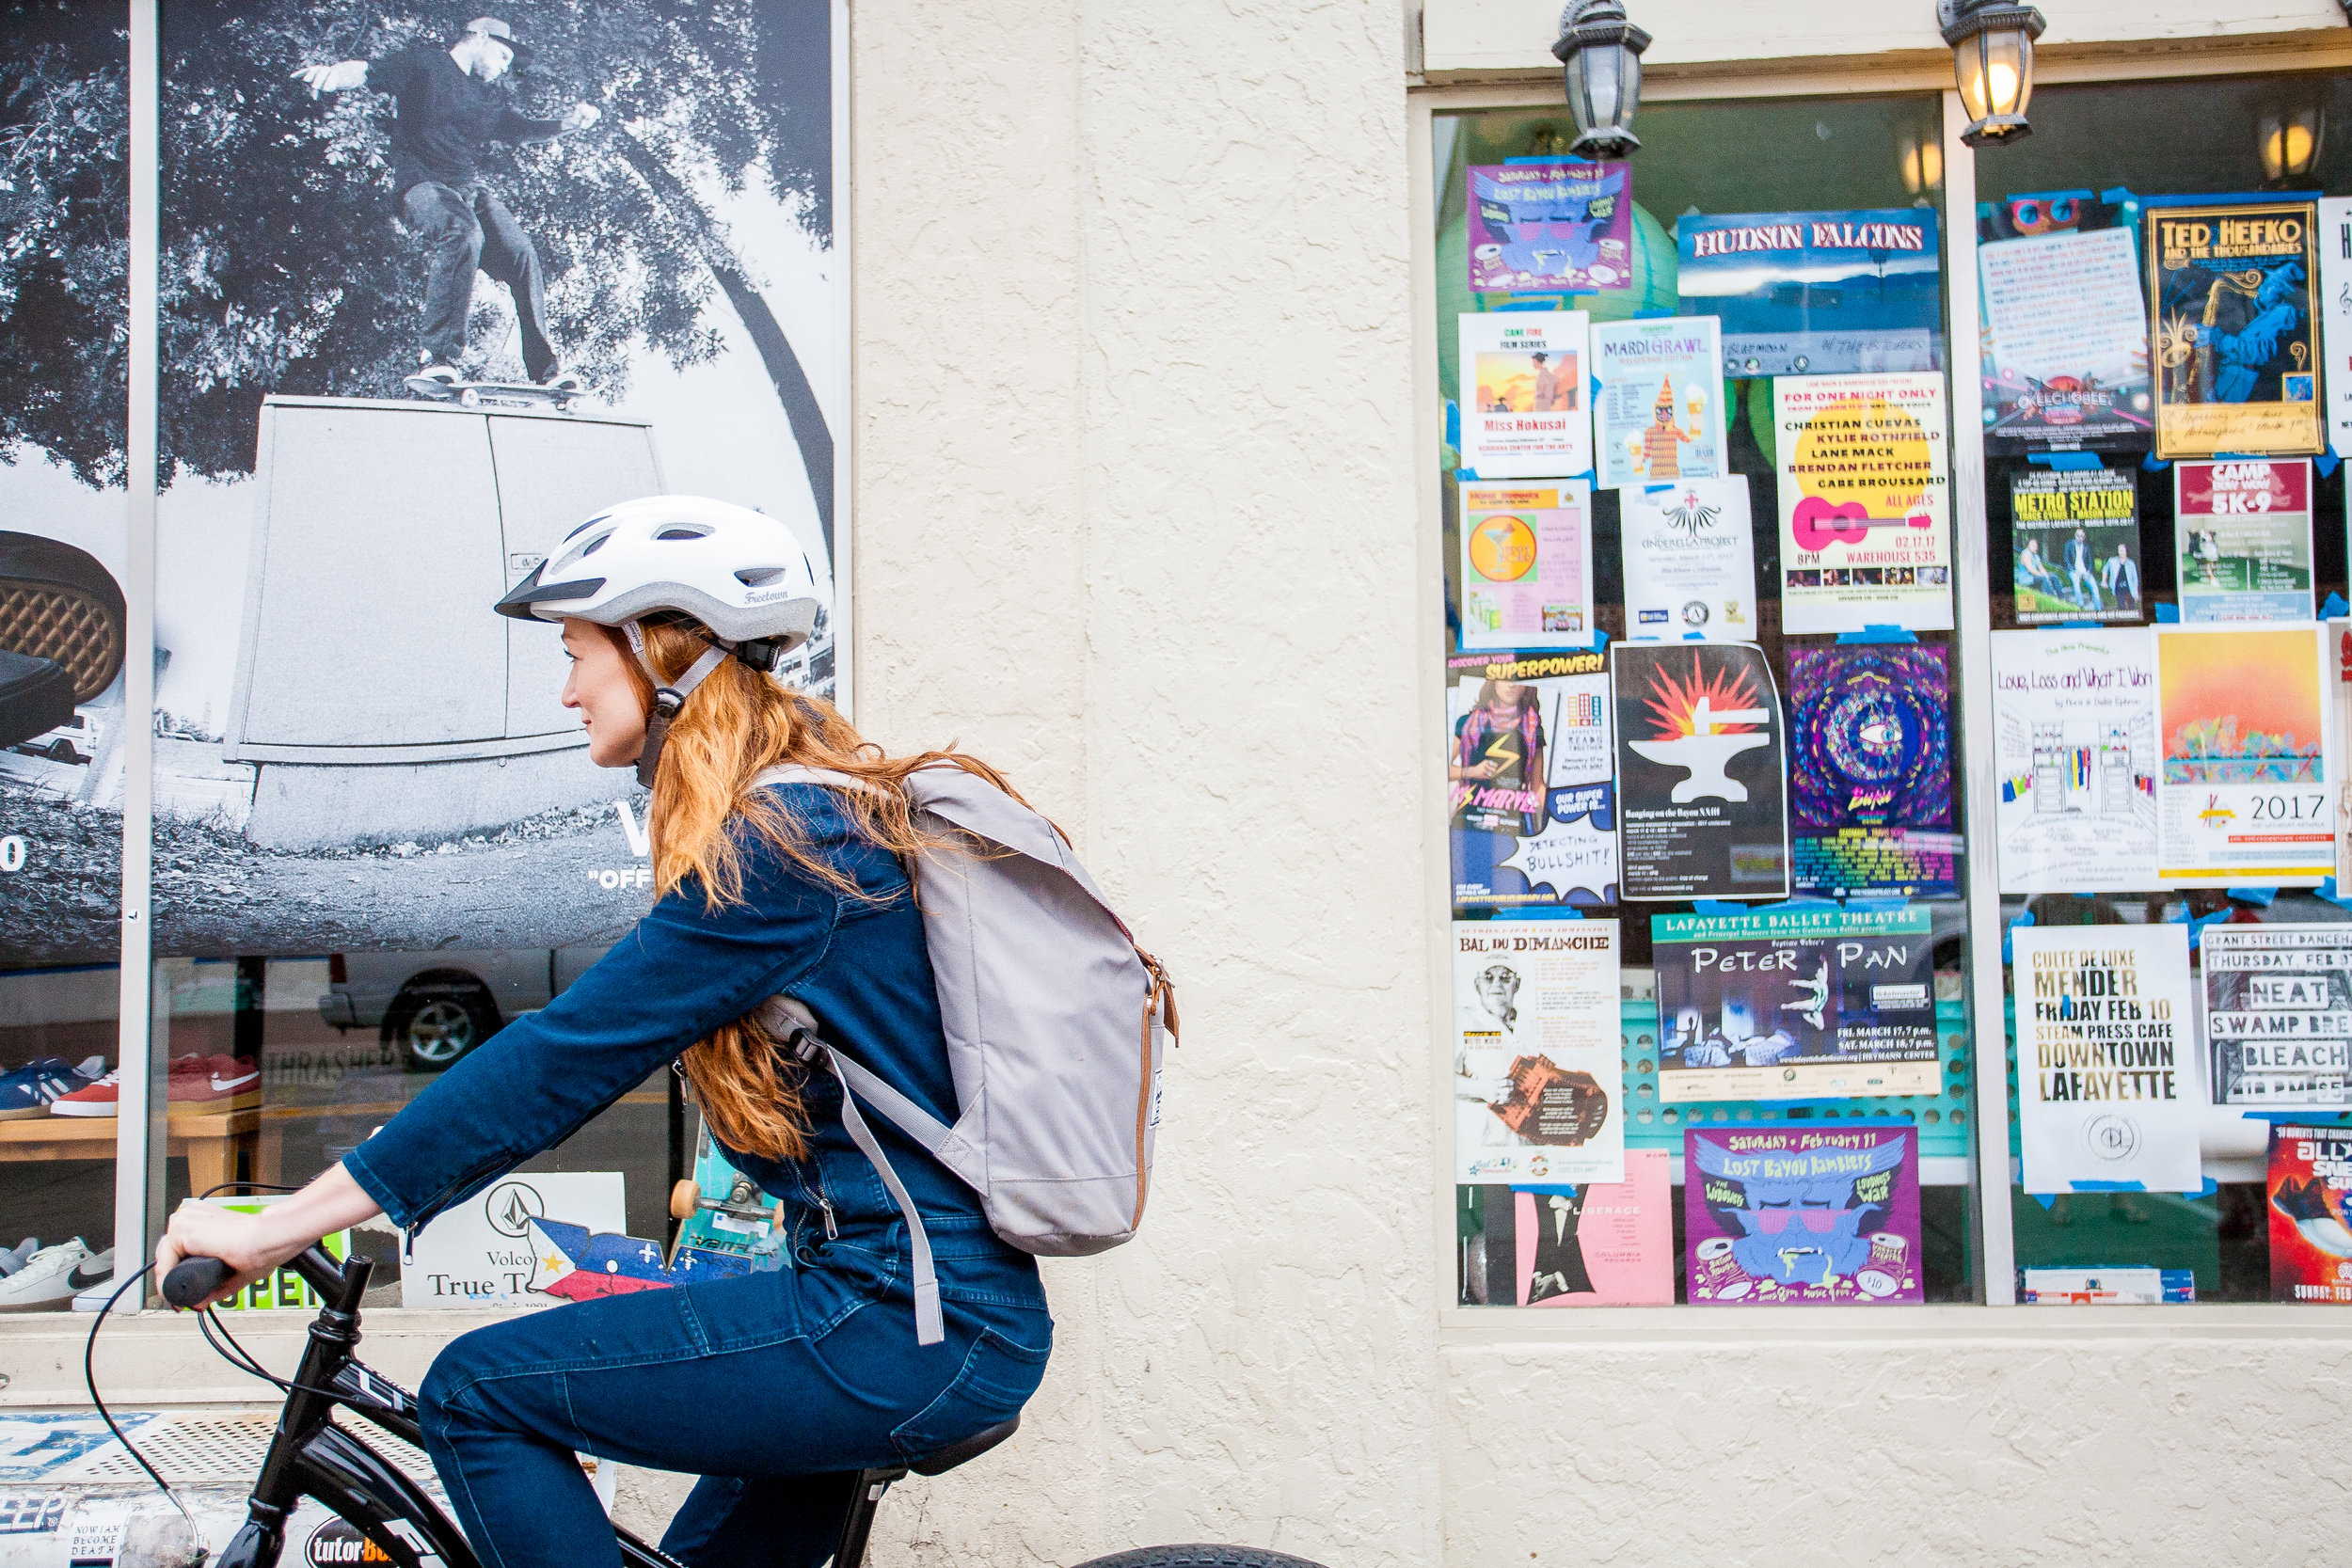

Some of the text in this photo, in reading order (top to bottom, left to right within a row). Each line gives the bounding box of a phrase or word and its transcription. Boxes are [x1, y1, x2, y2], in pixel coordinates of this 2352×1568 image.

[1693, 221, 1923, 258] HUDSON FALCONS
[2162, 218, 2301, 249] TED HEFKO
[2164, 243, 2301, 259] AND THE THOUSANDAIRES
[1604, 338, 1708, 356] MARDI GRAWL
[1785, 388, 1936, 403] FOR ONE NIGHT ONLY
[1485, 418, 1566, 431] Miss Hokusai
[1785, 419, 1921, 431] CHRISTIAN CUEVAS
[1817, 432, 1940, 443] KYLIE ROTHFIELD
[1812, 448, 1895, 458] LANE MACK
[1788, 462, 1931, 473] BRENDAN FLETCHER
[2212, 464, 2271, 481] CAMP
[1818, 477, 1946, 488] GABE BROUSSARD
[2212, 480, 2270, 491] BOW WOW
[1886, 494, 1933, 508] ALL AGES
[2014, 489, 2134, 513] METRO STATION
[2212, 491, 2272, 515] 5K-9
[1642, 536, 1739, 549] CINDERELLA PROJECT
[1895, 535, 1935, 548] 02.17.17
[1797, 551, 1935, 565] 8PM WAREHOUSE 535
[744, 590, 789, 605] Freetown
[1448, 654, 1516, 668] DISCOVER YOUR
[1486, 653, 1604, 680] SUPERPOWER!
[1997, 666, 2125, 695] Love, Loss and What I
[1567, 736, 1603, 746] READS
[1473, 786, 1539, 814] MARVEL
[1555, 788, 1604, 805] OUR SUPER
[1557, 801, 1588, 815] POWER
[2251, 795, 2325, 820] 2017
[1530, 835, 1598, 852] DETECTING
[1527, 847, 1610, 872] BULLSHIT!
[587, 868, 652, 890] "OFF
[1666, 911, 1917, 931] LAFAYETTE BALLET THEATRE
[1693, 931, 1707, 941] and
[1771, 928, 1788, 938] from
[1789, 928, 1801, 937] the
[2206, 933, 2352, 946] GRANT STREET DANCEH
[1460, 937, 1610, 952] BAL DU DIMANCHE
[2033, 949, 2137, 968] CULTE DE LUXE
[2306, 953, 2334, 966] FEB
[2033, 969, 2138, 998] MENDER
[2252, 982, 2326, 1004] NEAT
[2107, 999, 2142, 1021] FEB
[2149, 998, 2171, 1021] 10
[1837, 1027, 1855, 1038] FRI.
[1856, 1026, 1891, 1037] MARCH
[1893, 1025, 1905, 1036] 17,
[1913, 1025, 1932, 1036] p.m.
[2036, 1022, 2173, 1041] STEAM PRESS CAFE
[2213, 1016, 2300, 1034] SWAMP
[1838, 1040, 1858, 1051] SAT.
[1859, 1038, 1894, 1050] MARCH
[1915, 1038, 1935, 1049] p.m.
[1862, 1050, 1935, 1061] HEYMANN CENTER
[2038, 1041, 2175, 1069] DOWNTOWN
[2245, 1045, 2346, 1067] BLEACH
[2039, 1070, 2178, 1102] LAFAYETTE
[1800, 1133, 1860, 1149] February
[1864, 1132, 1877, 1148] 11
[2286, 1128, 2328, 1139] MOMENTS THAT
[1723, 1158, 1761, 1176] LOST
[1715, 1180, 1728, 1189] THE
[1857, 1187, 1890, 1204] WAR
[1573, 1206, 1642, 1216] LIBERACE
[427, 1273, 495, 1295] True
[1867, 1275, 1883, 1291] $10
[2294, 1284, 2333, 1300] SUNDAY,
[104, 1525, 120, 1533] AM
[73, 1535, 118, 1544] BECOME
[72, 1545, 116, 1556] DEATH
